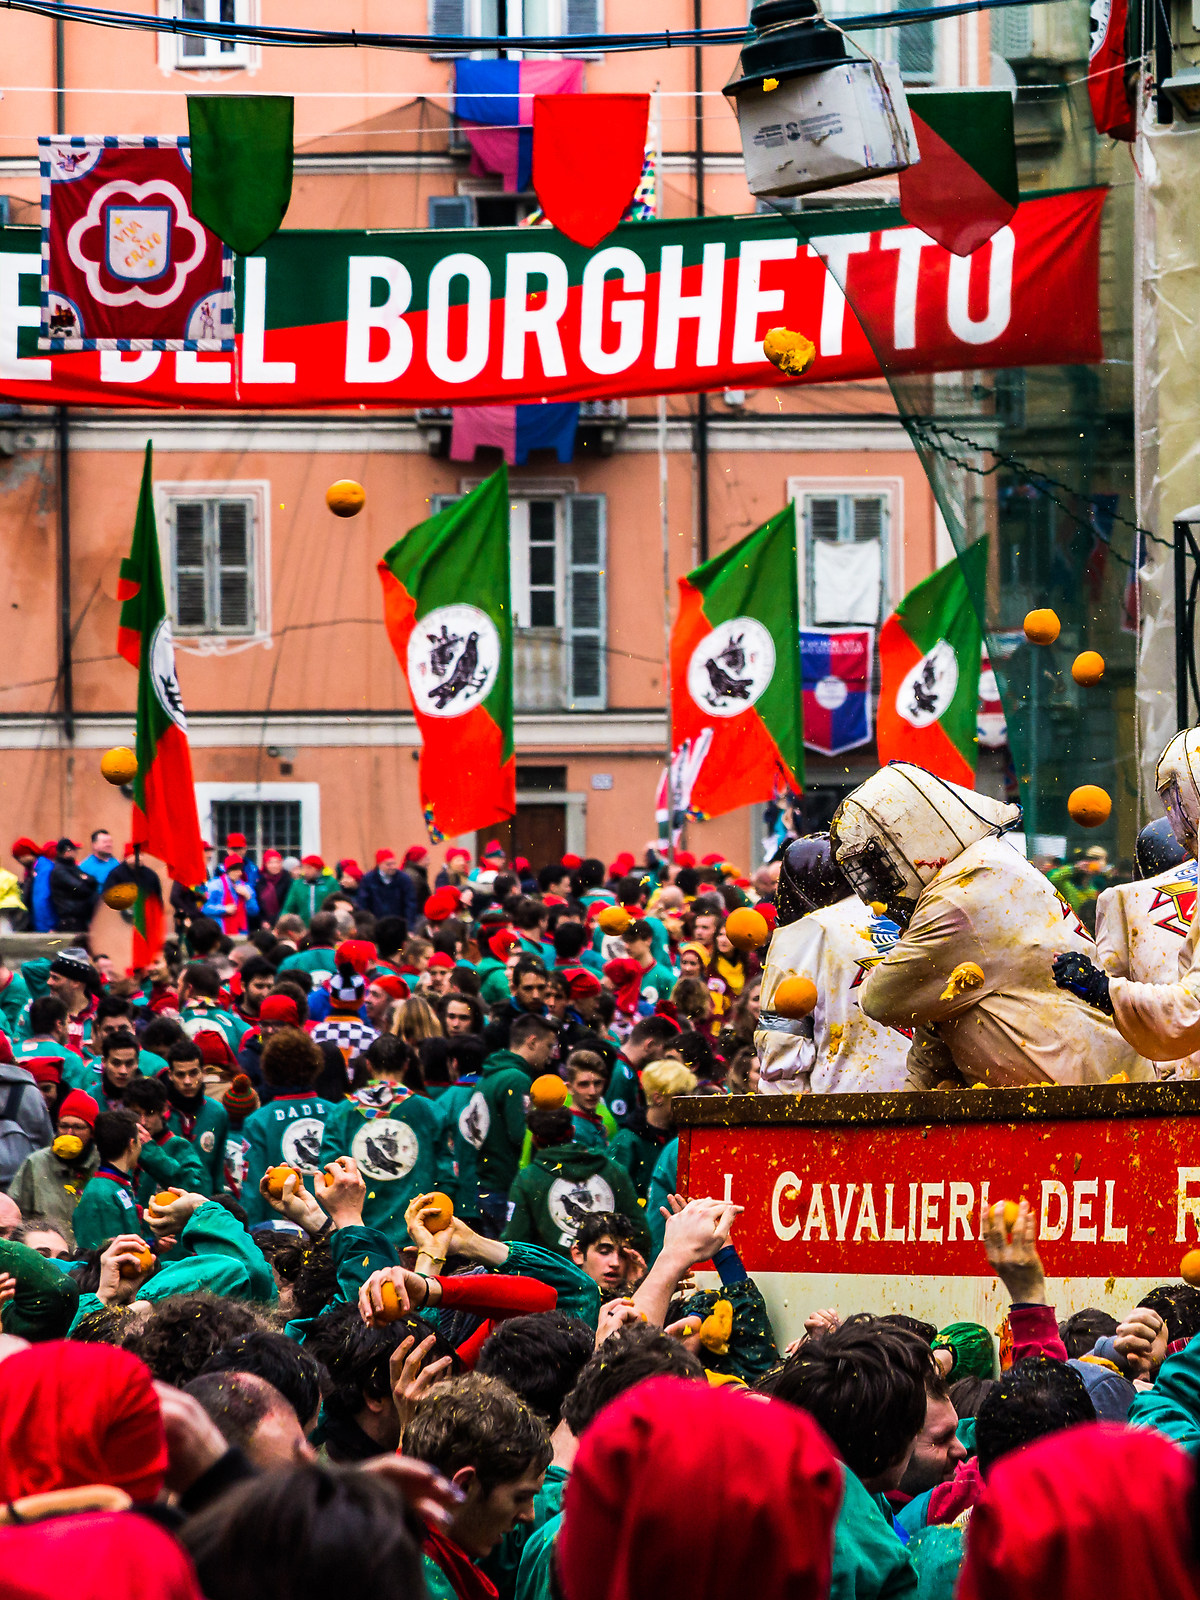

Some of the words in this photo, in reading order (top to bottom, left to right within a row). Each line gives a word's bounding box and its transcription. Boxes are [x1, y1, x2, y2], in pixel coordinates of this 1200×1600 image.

[344, 224, 1016, 384] BORGHETTO
[771, 1170, 990, 1245] CAVALIERI
[1038, 1177, 1128, 1245] DEL
